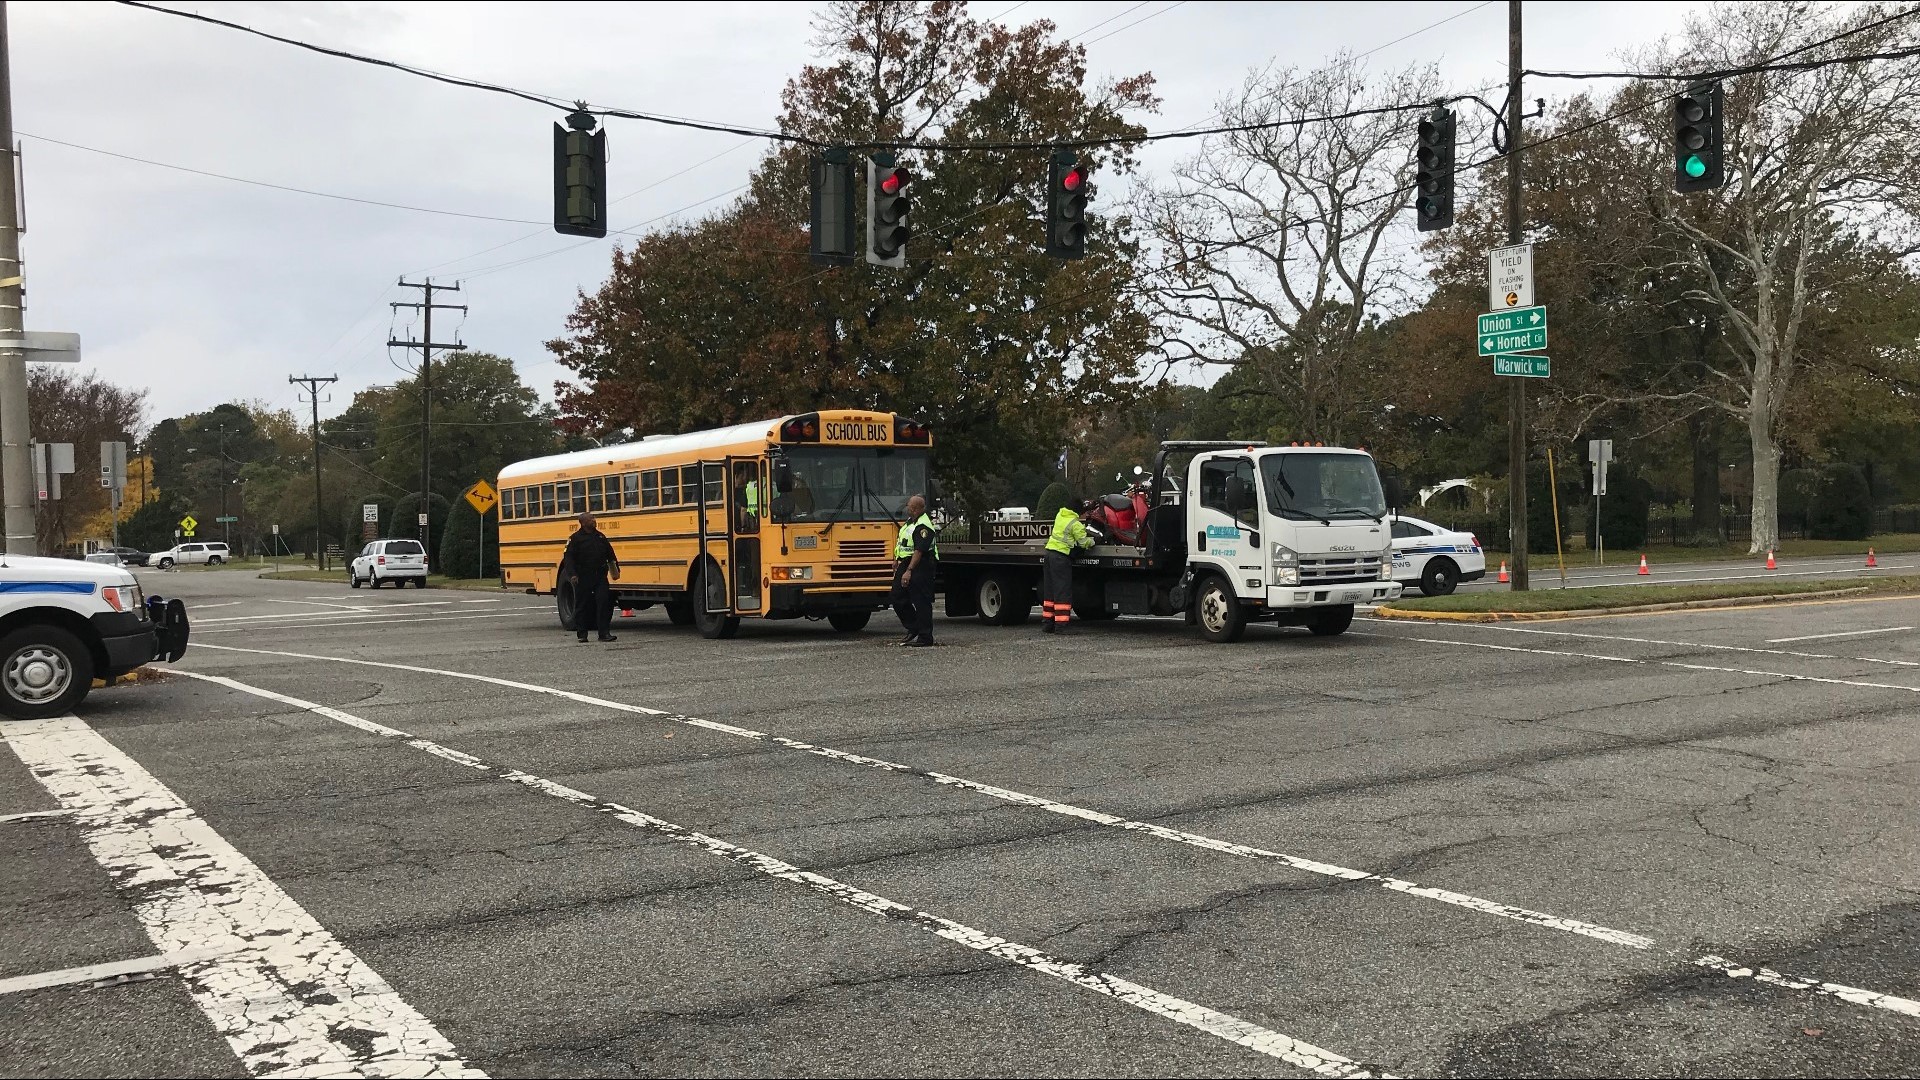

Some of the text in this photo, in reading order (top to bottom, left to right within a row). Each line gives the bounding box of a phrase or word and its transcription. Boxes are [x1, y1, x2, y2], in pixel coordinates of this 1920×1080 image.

[1495, 246, 1527, 258] LEFT TURN
[1501, 256, 1522, 267] YIELD
[1499, 275, 1524, 284] FLASHING
[1501, 285, 1523, 293] YELLOW
[1482, 316, 1523, 332] Union St
[1497, 333, 1543, 350] Hornet Cir
[1497, 358, 1547, 374] Warwick Blvd
[826, 422, 887, 442] SCHOOL BUS
[993, 524, 1053, 537] HUNTINGT
[1392, 561, 1411, 569] EWS
